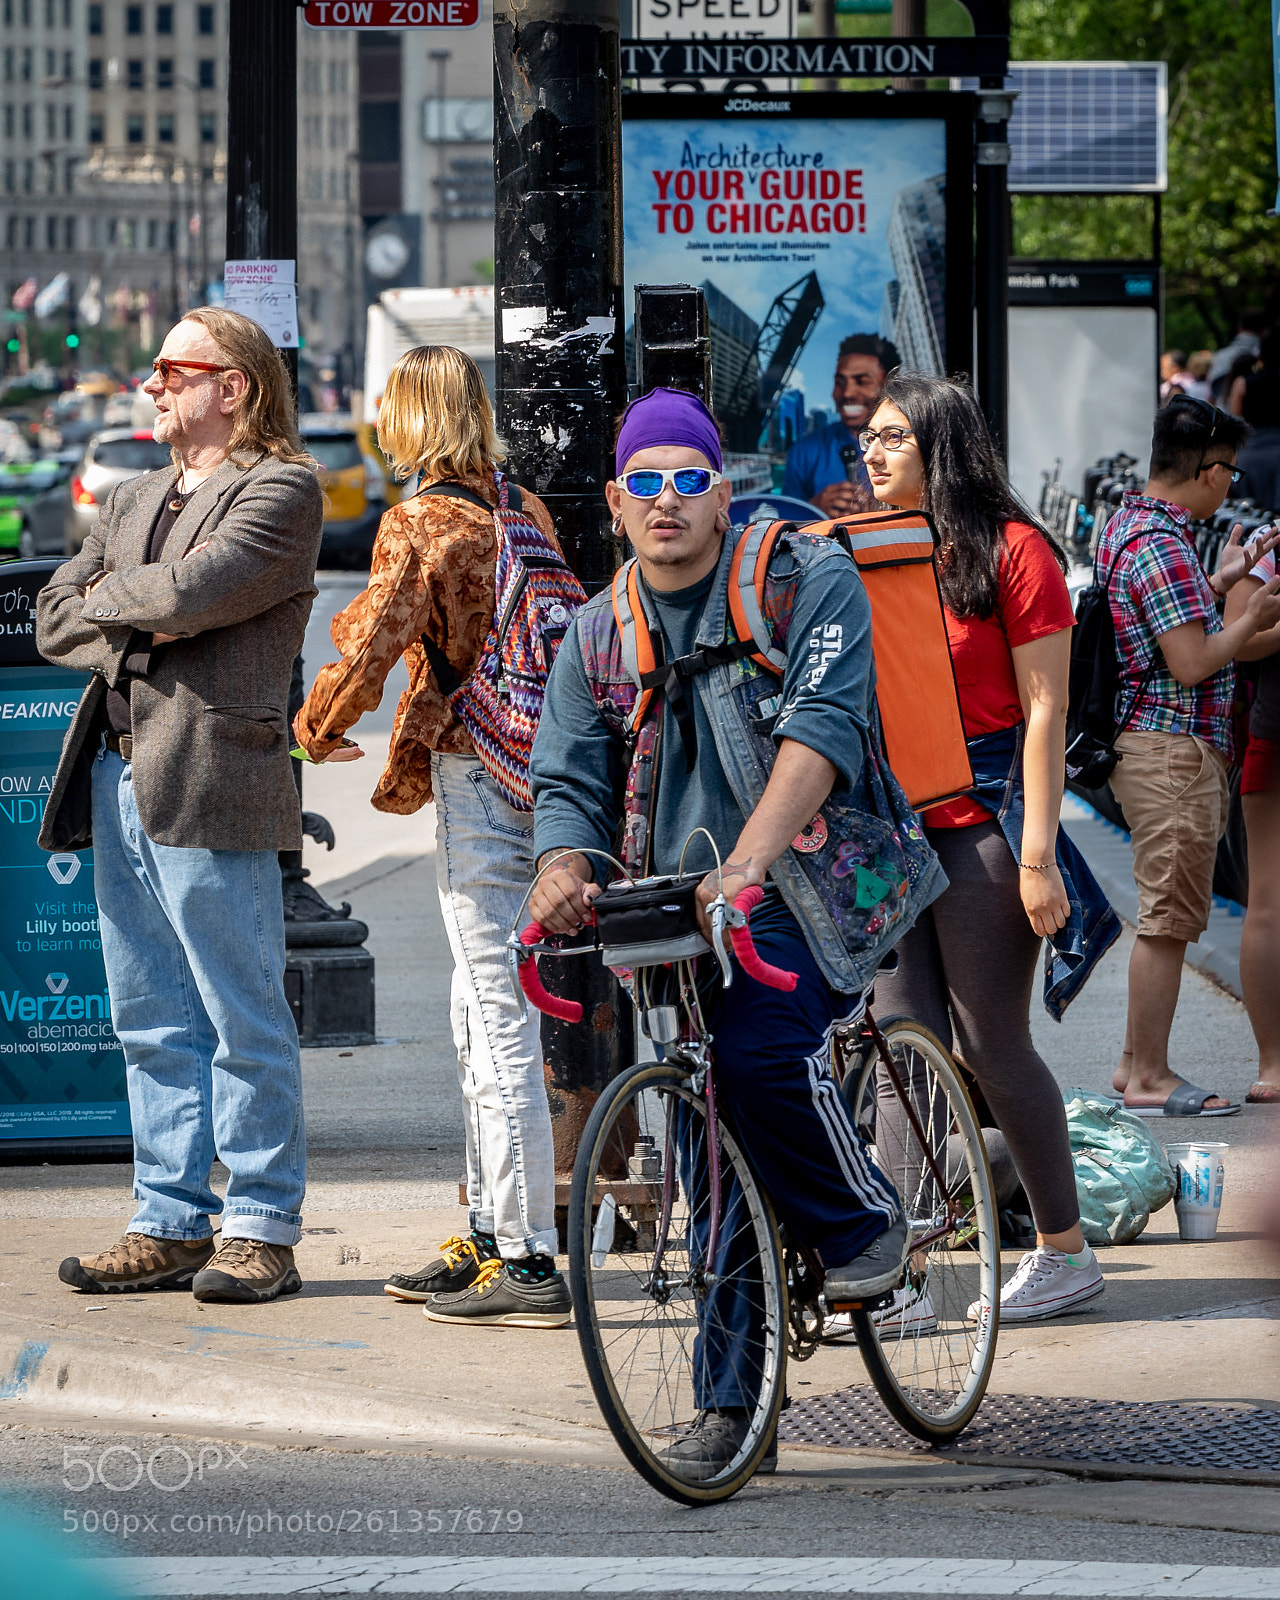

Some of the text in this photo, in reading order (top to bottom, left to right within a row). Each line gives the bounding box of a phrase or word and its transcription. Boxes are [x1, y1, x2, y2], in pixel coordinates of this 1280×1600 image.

[315, 2, 463, 23] TOW ZONE
[650, 0, 780, 18] SPEED
[683, 44, 936, 73] INFORMATION
[724, 99, 791, 112] JCDecaux
[680, 140, 824, 169] Architecture
[652, 169, 863, 201] YOUR GUIDE
[652, 202, 866, 234] TO CHICAGO!
[761, 242, 778, 250] and
[733, 254, 789, 262] Architecture
[235, 264, 278, 274] PARKING
[246, 275, 274, 285] ZONE
[1049, 274, 1080, 288] Park
[0, 701, 79, 719] EAKING
[35, 900, 96, 916] Visit the
[26, 918, 100, 936] Lilly boot
[16, 938, 32, 952] to
[37, 937, 73, 952] learn
[27, 1021, 115, 1039] abemacic
